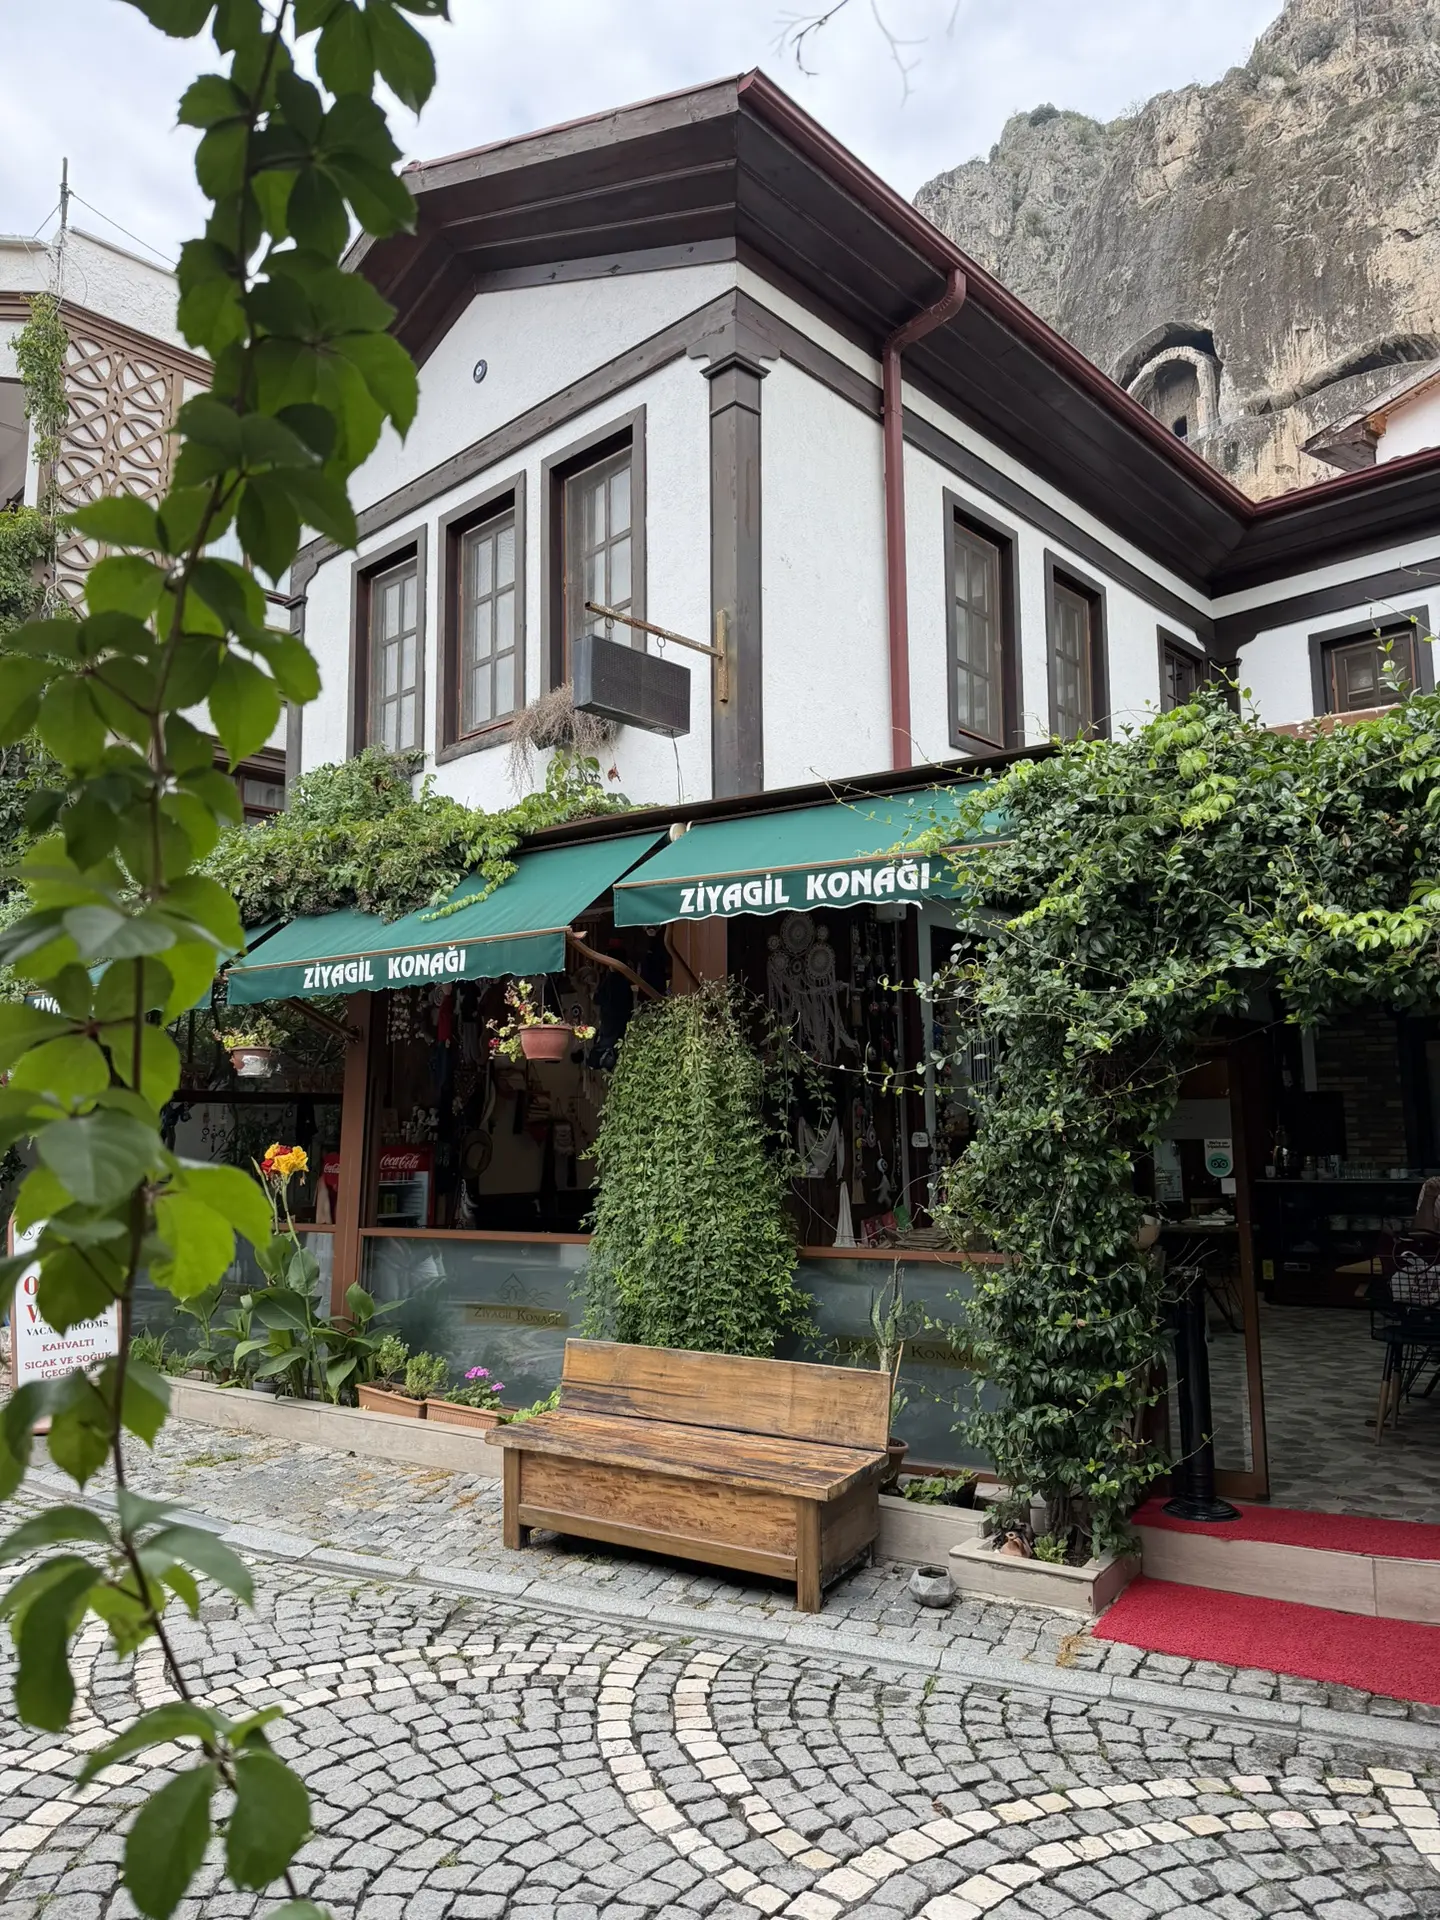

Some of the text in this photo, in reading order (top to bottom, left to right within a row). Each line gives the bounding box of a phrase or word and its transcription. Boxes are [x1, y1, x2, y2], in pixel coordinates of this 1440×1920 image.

[679, 859, 931, 914] ZİYAGİL KONAĞI
[303, 946, 467, 989] ZİYAGİL KONAĞI
[379, 1152, 421, 1170] Coca-Cola
[26, 1318, 109, 1337] VACA ROOMS
[42, 1338, 95, 1352] KAHVALTI
[24, 1351, 112, 1370] SICAK VE SOĞUK
